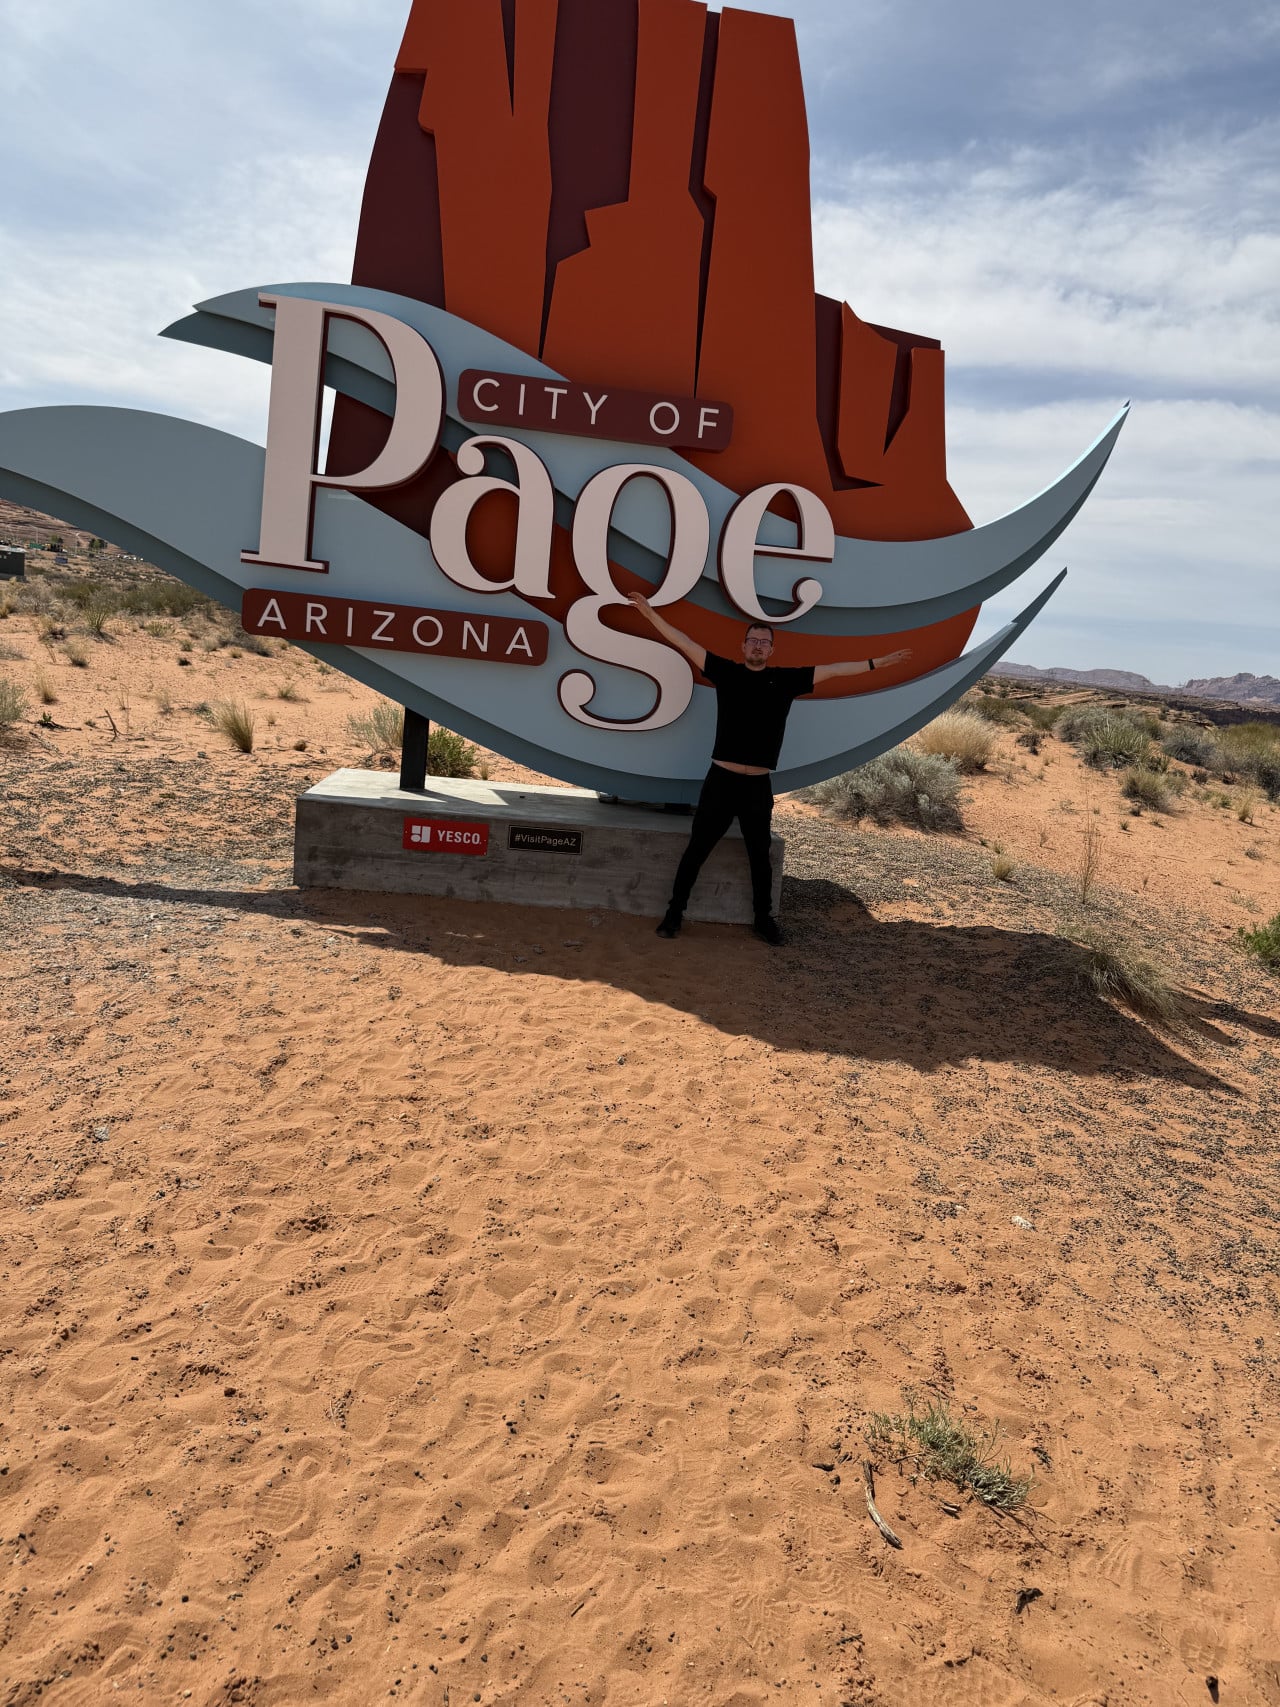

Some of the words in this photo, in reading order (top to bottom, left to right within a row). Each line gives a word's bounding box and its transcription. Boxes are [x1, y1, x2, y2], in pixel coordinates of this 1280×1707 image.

[472, 378, 608, 425] CITY
[648, 401, 720, 439] OF
[241, 292, 835, 732] Page
[257, 598, 533, 658] ARIZONA
[437, 829, 481, 845] YESCO
[514, 833, 576, 847] #VisitPageAZ
